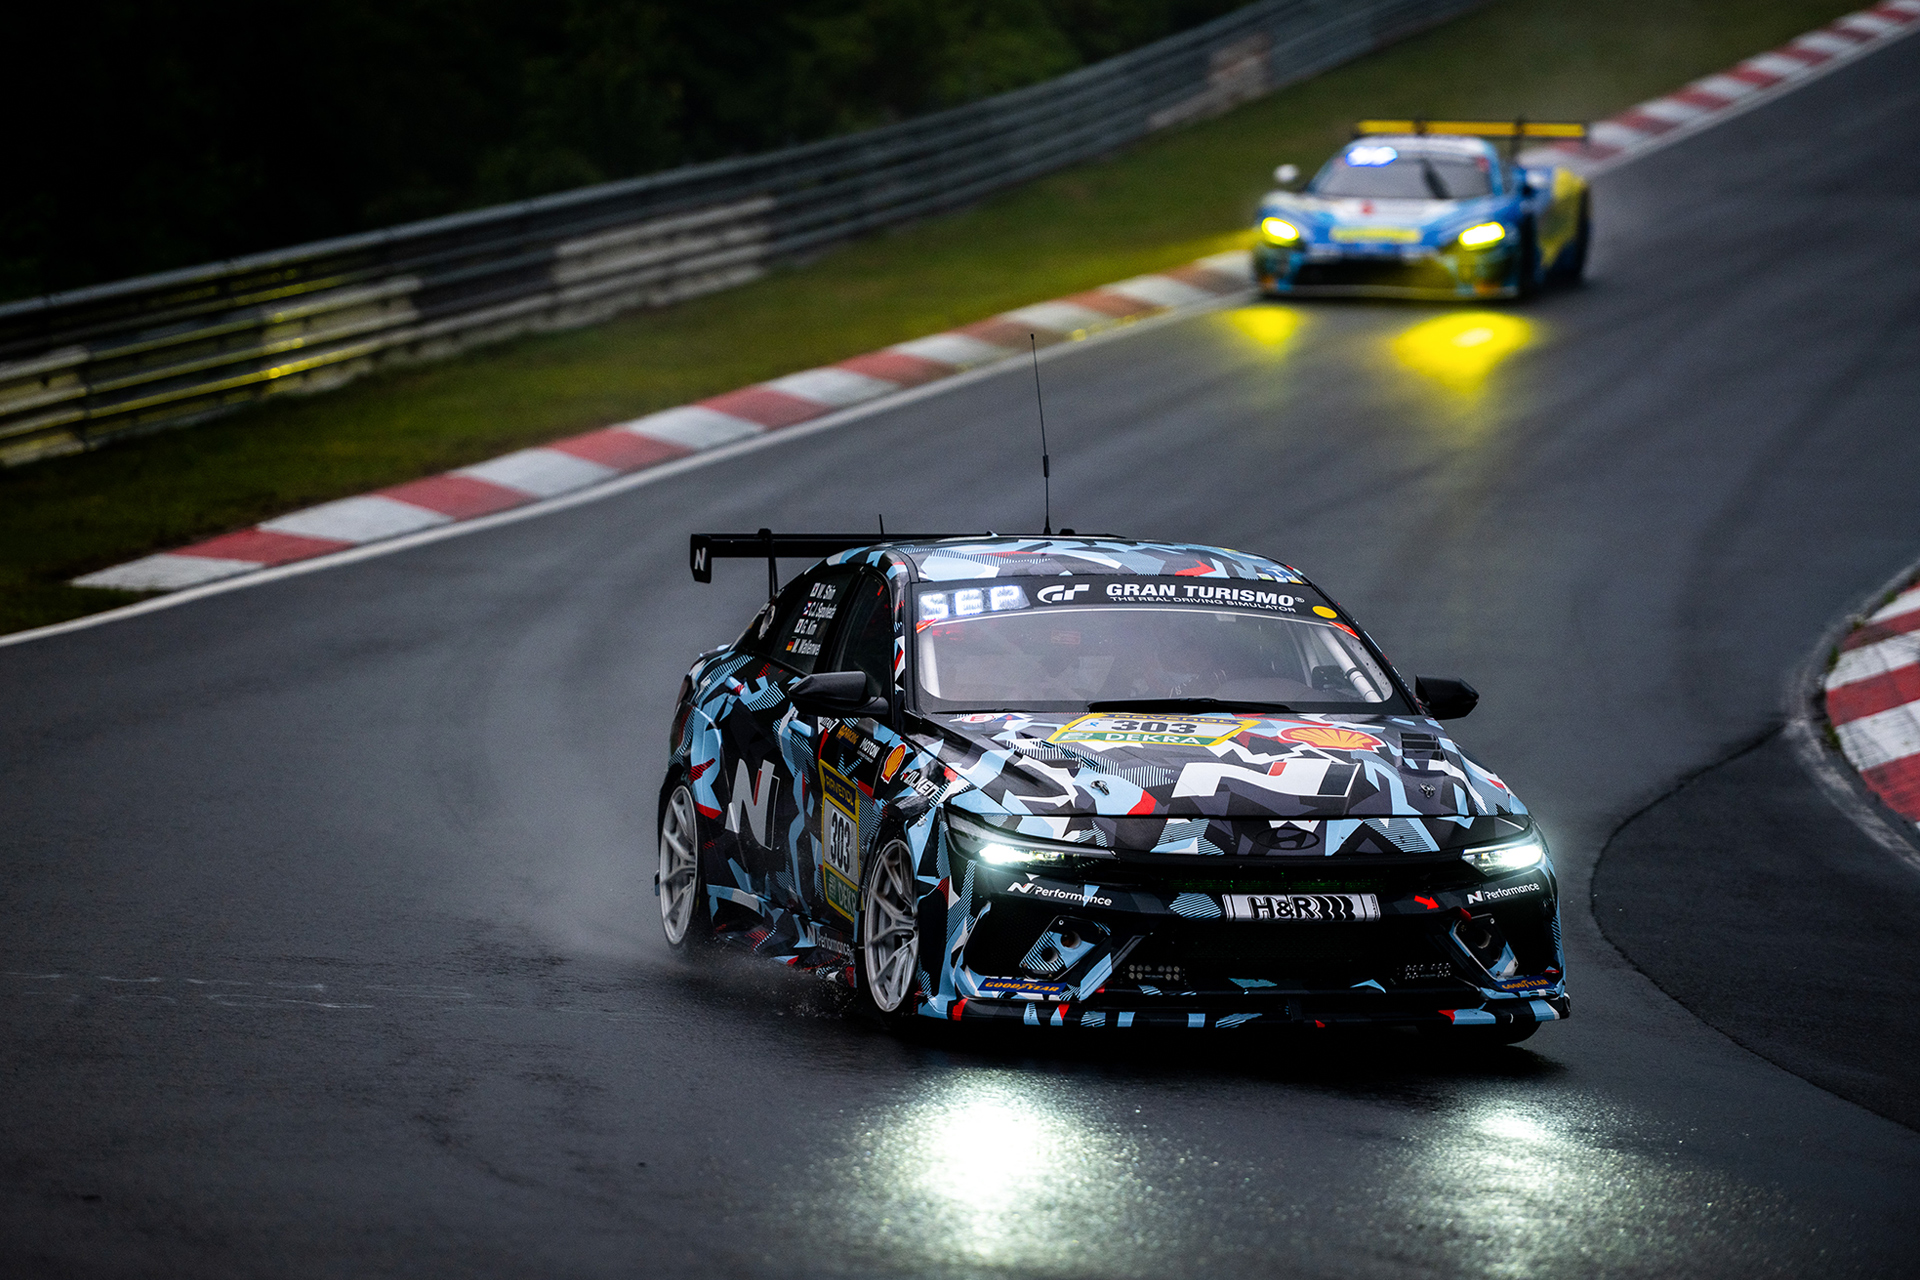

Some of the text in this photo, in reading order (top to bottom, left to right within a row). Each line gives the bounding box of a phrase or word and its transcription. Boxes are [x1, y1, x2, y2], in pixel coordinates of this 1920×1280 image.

[694, 547, 706, 571] N
[1106, 583, 1176, 597] GRAN
[1173, 597, 1222, 605] DRIVING
[1222, 600, 1297, 613] SIMULATOR
[1111, 720, 1198, 734] 303
[1105, 732, 1201, 745] DEKRA
[825, 774, 854, 807] RAVENOL
[830, 811, 851, 873] 303
[1035, 886, 1113, 906] Performance
[1485, 882, 1541, 900] Performance
[1248, 896, 1321, 920] H&R
[985, 981, 1060, 992] GOODYEAR
